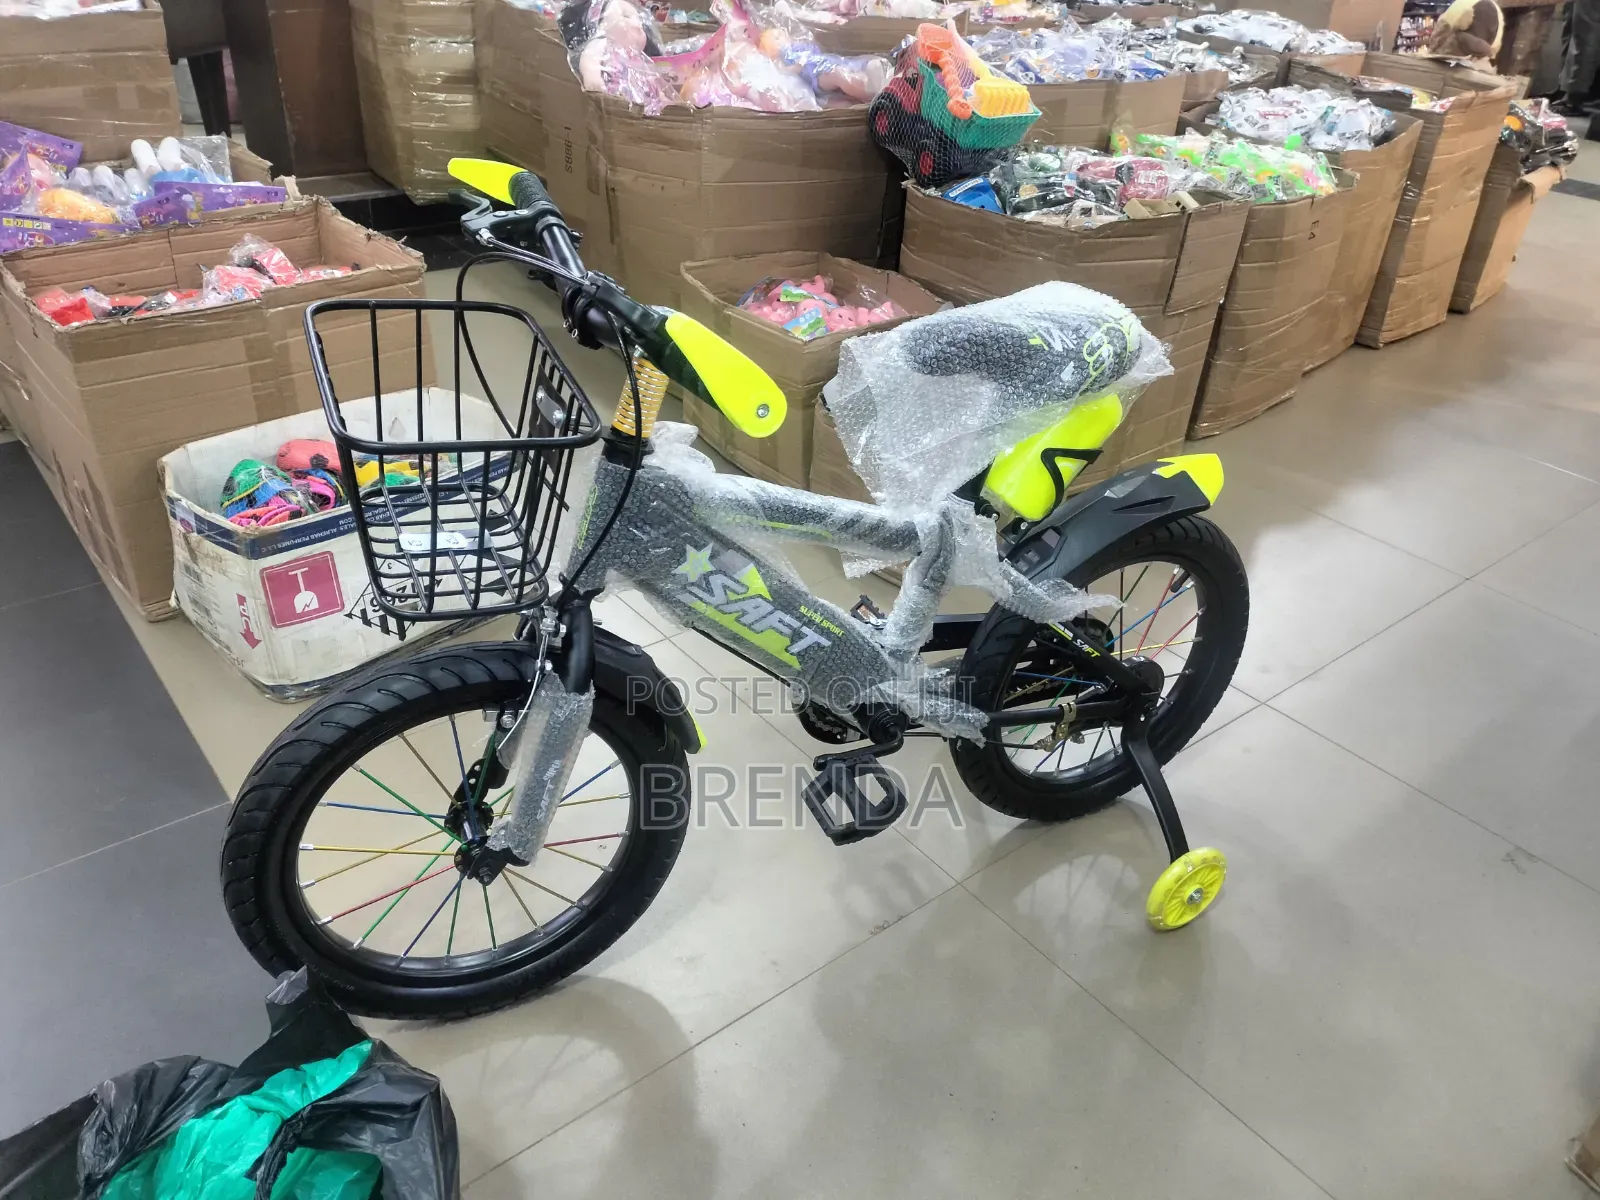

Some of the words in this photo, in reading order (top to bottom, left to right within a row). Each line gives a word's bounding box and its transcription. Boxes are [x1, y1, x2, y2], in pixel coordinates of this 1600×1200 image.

[277, 535, 310, 548] PERFUMES
[239, 601, 253, 635] UP
[686, 572, 832, 655] SAFT
[798, 605, 822, 624] SUPER
[820, 619, 846, 638] SPORT
[1072, 638, 1101, 658] SAFT
[542, 759, 563, 781] SUPER
